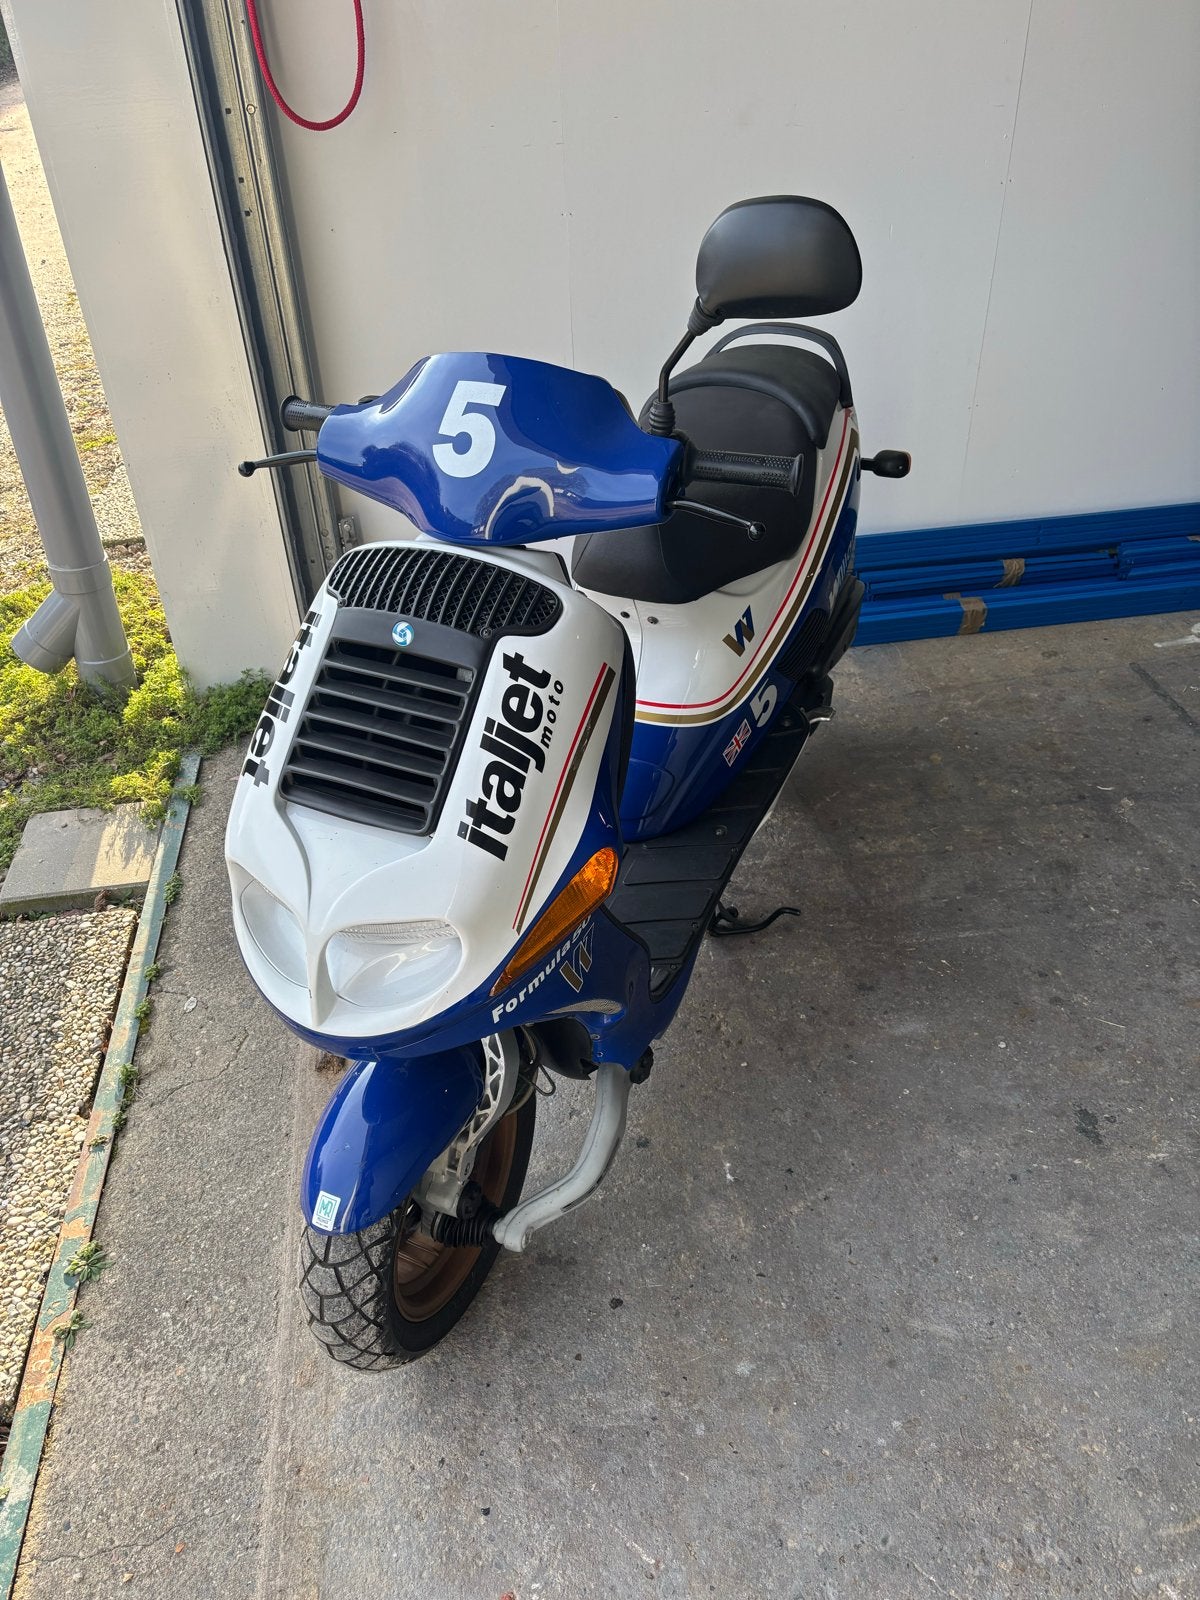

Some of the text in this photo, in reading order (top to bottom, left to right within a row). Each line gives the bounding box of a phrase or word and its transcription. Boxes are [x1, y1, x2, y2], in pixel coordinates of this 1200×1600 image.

[432, 380, 507, 478] 5
[540, 680, 564, 749] moto
[750, 679, 778, 728] 5
[457, 652, 551, 861] italjet
